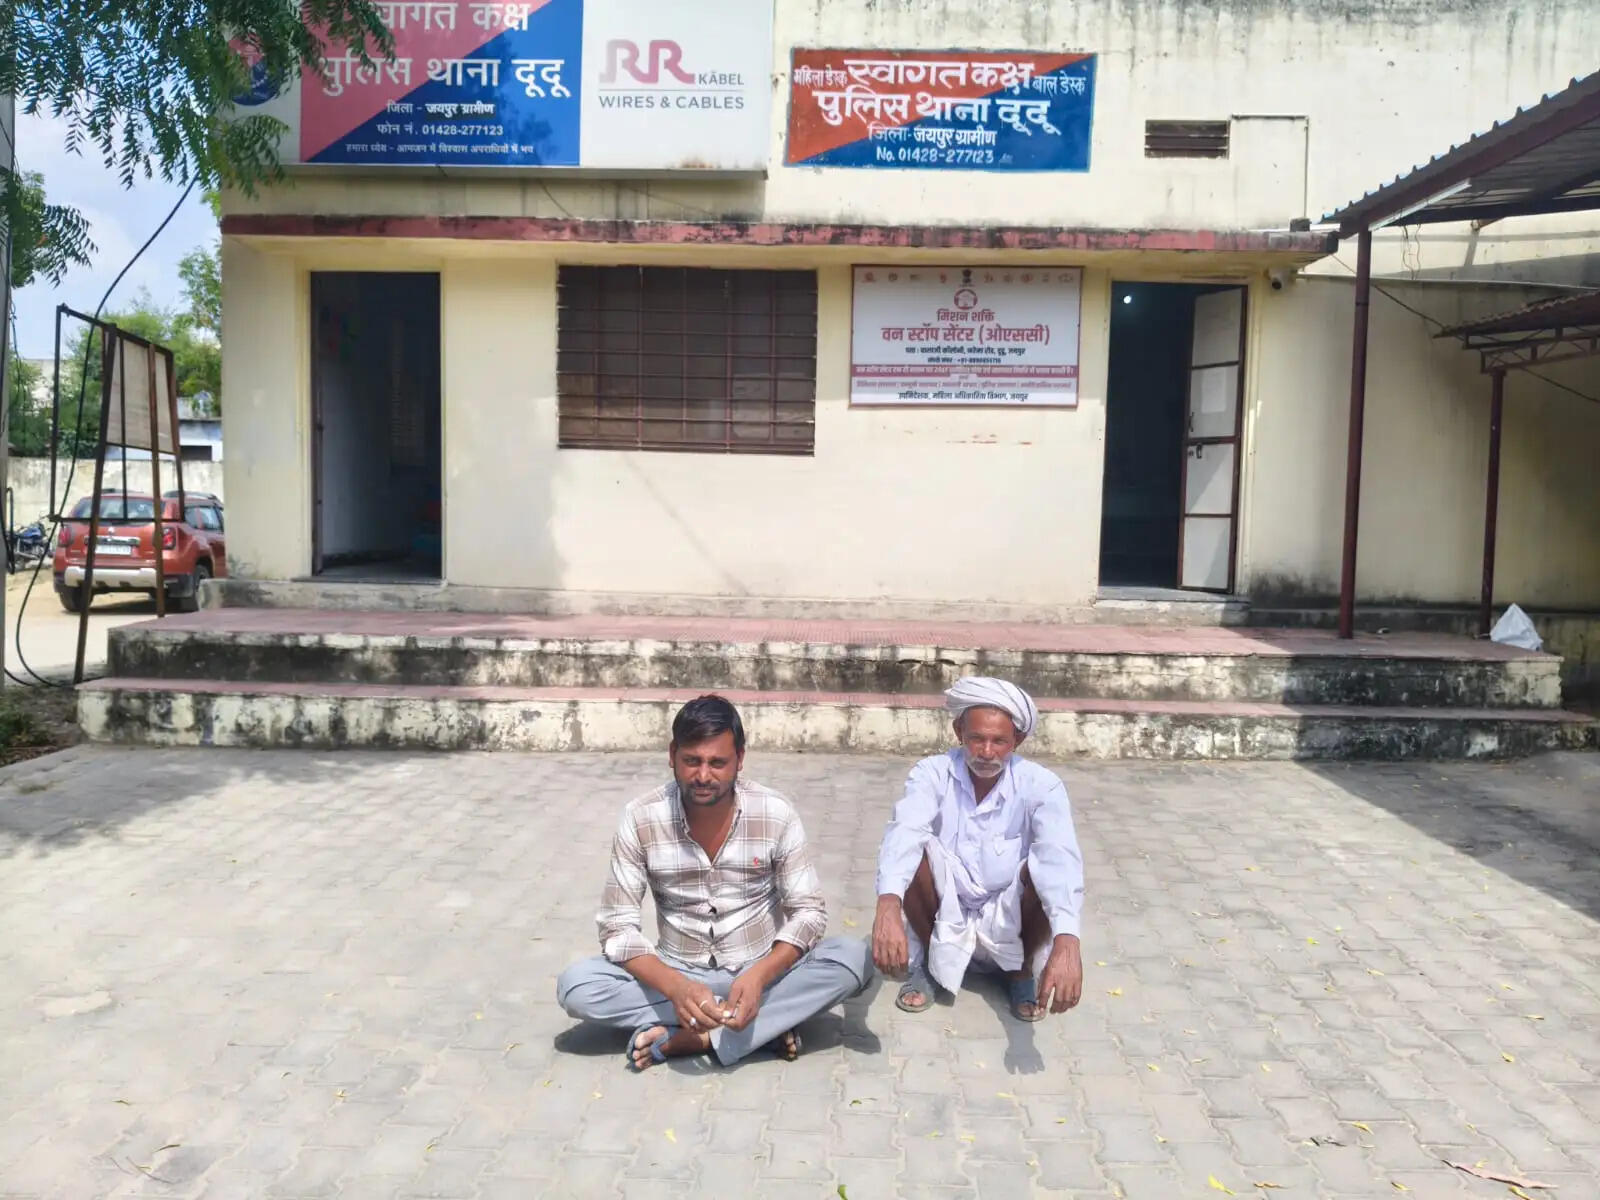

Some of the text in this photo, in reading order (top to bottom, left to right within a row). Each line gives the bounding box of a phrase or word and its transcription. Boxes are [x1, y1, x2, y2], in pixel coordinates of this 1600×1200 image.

[370, 1, 531, 31] वागत कक्ष
[319, 47, 572, 98] पुलिस थाना दूदू
[598, 39, 696, 85] RR
[843, 58, 1035, 96] स्वागत कक्ष
[1032, 69, 1087, 98] बाल डेस्क
[386, 99, 413, 114] जिला
[425, 102, 458, 118] जयपुर
[460, 101, 496, 115] ग्रामीण
[599, 96, 744, 110] WIRES & CABLES
[811, 83, 1062, 137] पुलिस थाना दूदू
[377, 120, 400, 136] फोन
[421, 124, 504, 136] 01428-277123
[913, 124, 954, 150] जयपुर
[955, 124, 998, 147] ग्रामीण
[876, 145, 895, 161] No.
[898, 147, 995, 164] 01428-277123
[936, 308, 996, 322] मिशन शक्ति
[881, 322, 1051, 345] वन स्टॉप सेंटर (ओएससी)
